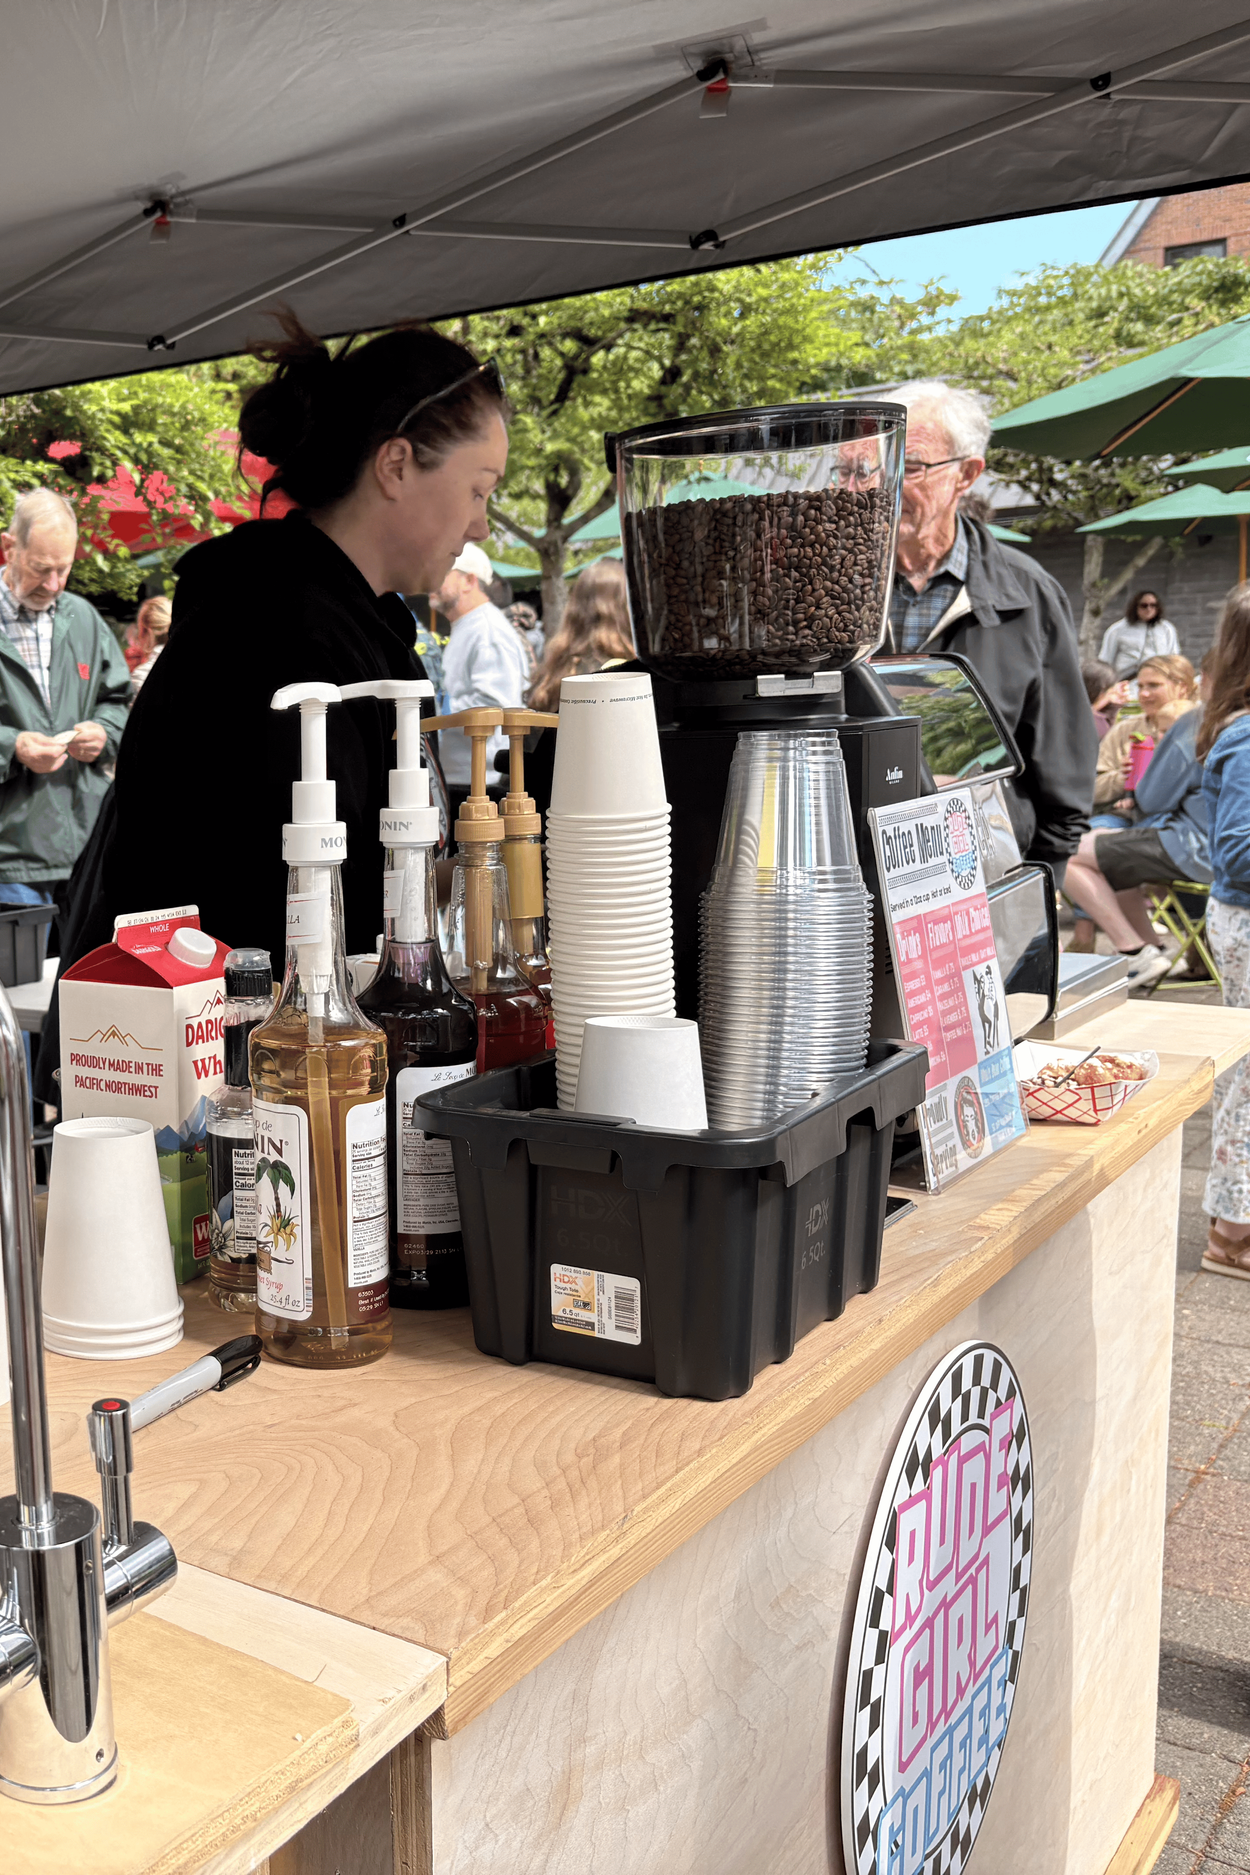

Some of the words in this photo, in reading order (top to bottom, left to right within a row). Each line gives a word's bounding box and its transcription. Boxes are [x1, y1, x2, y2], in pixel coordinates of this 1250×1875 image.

[947, 811, 968, 834] RUDE
[882, 825, 916, 873] Coffee
[915, 823, 944, 865] Menu
[951, 835, 970, 854] GIRL
[952, 851, 975, 874] COFFEE
[890, 900, 905, 912] Served
[922, 892, 930, 903] cup
[150, 923, 170, 934] WHOLE
[928, 920, 953, 949] Flavors
[954, 912, 969, 940] Milk
[896, 930, 921, 962] Drinks
[912, 1026, 924, 1042] LATTE
[70, 1053, 108, 1070] PROUDLY
[108, 1059, 133, 1074] MADE
[134, 1062, 144, 1075] IN
[145, 1062, 164, 1077] THE
[74, 1075, 104, 1092] PACIFIC
[104, 1078, 159, 1099] NORTHWEST
[921, 1092, 948, 1129] Proudly
[262, 1120, 272, 1132] de
[352, 1139, 380, 1149] Nutrition
[352, 1163, 373, 1171] Calories
[930, 1144, 958, 1178] Serving
[235, 1181, 255, 1189] Calor
[550, 1186, 632, 1227] HDX
[266, 1277, 283, 1294] Syrup
[554, 1272, 578, 1286] HDX
[270, 1294, 283, 1305] 25.4
[283, 1295, 290, 1308] fl
[292, 1299, 300, 1307] oz
[562, 1308, 573, 1316] 6.5
[891, 1396, 1015, 1648] RUDE
[898, 1557, 1000, 1774] GIRL
[876, 1644, 1010, 1875] COFFEE
